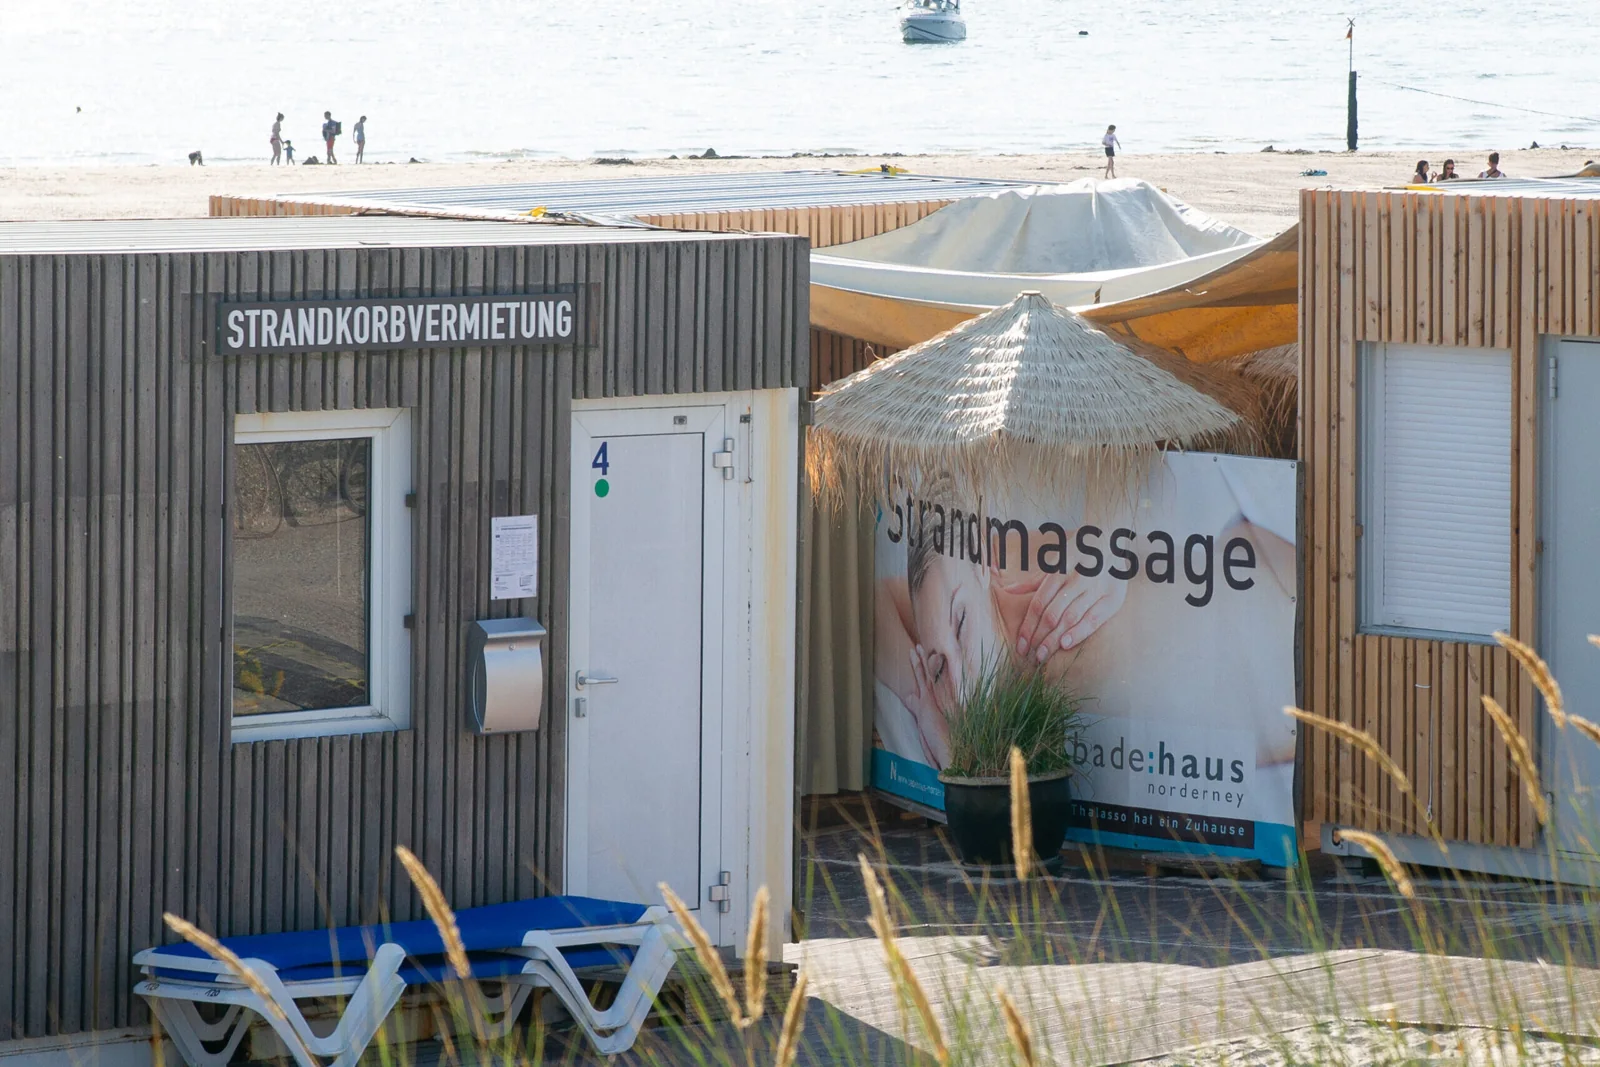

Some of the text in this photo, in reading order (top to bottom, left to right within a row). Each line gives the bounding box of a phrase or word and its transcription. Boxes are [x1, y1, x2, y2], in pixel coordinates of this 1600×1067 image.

[227, 300, 572, 348] STRANDKORBVERMIETUNG
[591, 441, 610, 476] 4
[887, 474, 1257, 607] Strandmassage
[1072, 731, 1245, 784] bade:haus
[1147, 782, 1245, 808] norderney
[1071, 803, 1245, 837] Thalasso hat ein Zuhause
